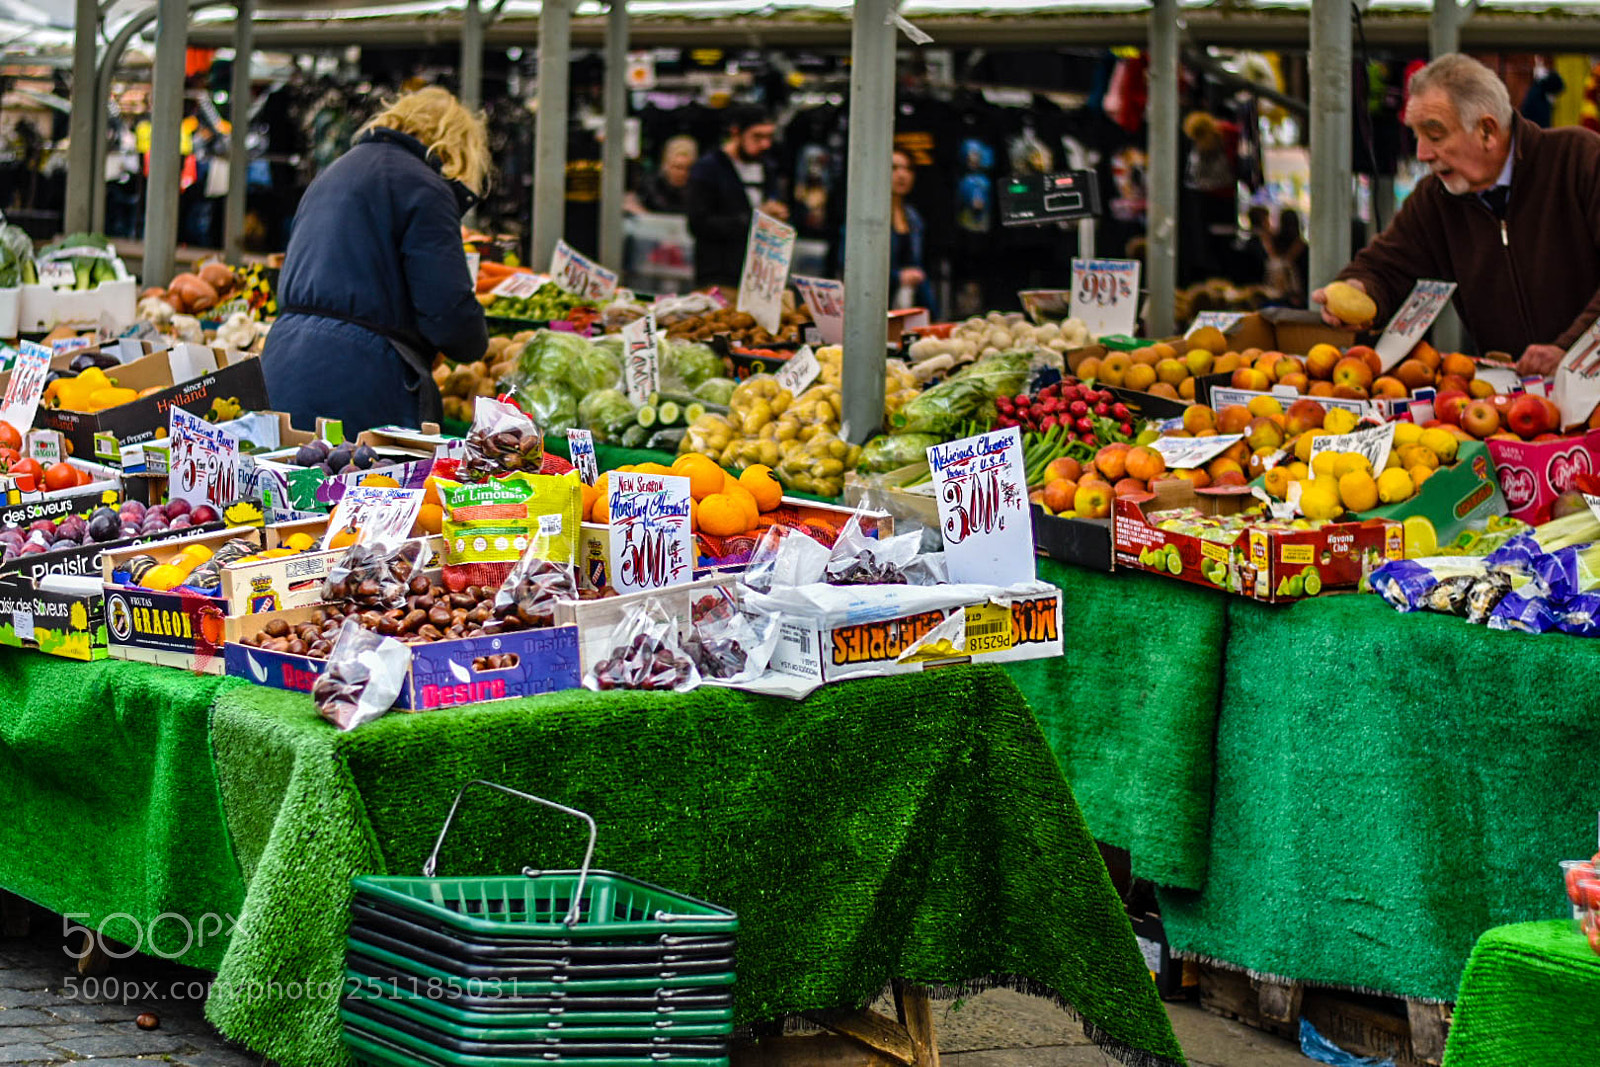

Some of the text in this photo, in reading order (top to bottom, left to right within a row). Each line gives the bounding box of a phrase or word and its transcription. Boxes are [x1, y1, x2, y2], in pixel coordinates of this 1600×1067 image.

[156, 387, 208, 414] Holland
[126, 431, 153, 444] Peppers
[238, 470, 259, 487] Flora
[1556, 452, 1580, 487] Pink
[1505, 473, 1526, 490] Pink
[451, 491, 464, 504] du
[2, 498, 73, 523] des Saveurs
[1327, 534, 1354, 544] Havana
[1333, 543, 1348, 553] Club
[32, 554, 88, 579] Plaisir
[33, 597, 69, 618] Saveurs
[130, 596, 153, 608] FRUTAS
[133, 607, 192, 639] GRAGON
[970, 633, 1011, 652] P62518
[422, 678, 506, 708] Desire
